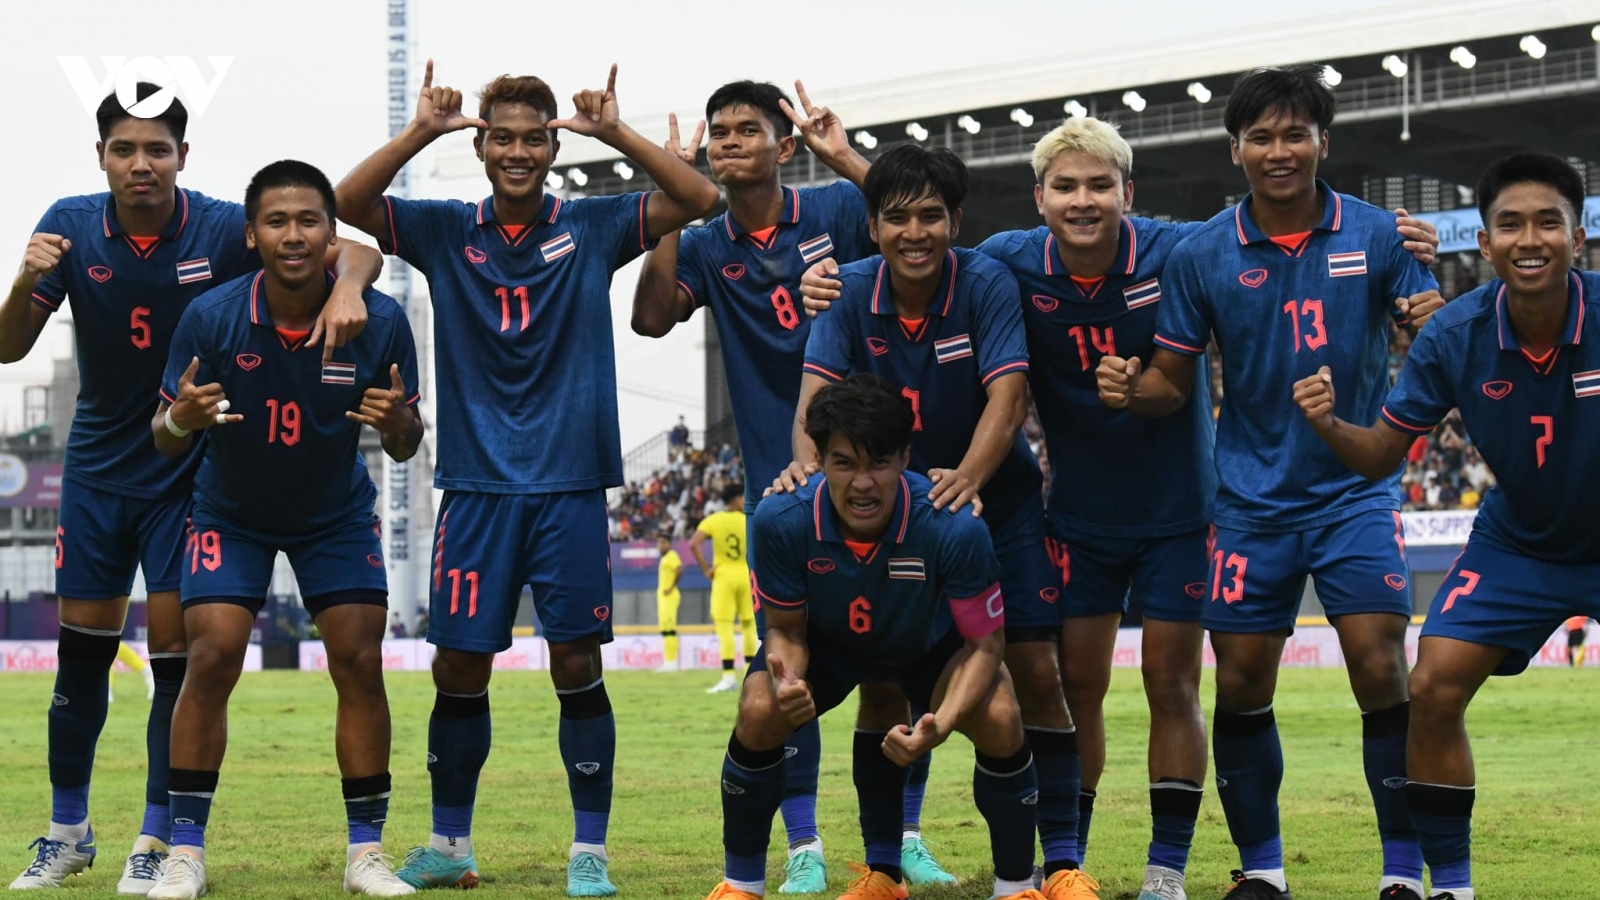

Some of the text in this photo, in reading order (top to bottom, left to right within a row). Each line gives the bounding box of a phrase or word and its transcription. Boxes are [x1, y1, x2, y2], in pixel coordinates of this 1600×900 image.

[130, 306, 151, 350] 5
[495, 286, 530, 331] 11
[770, 285, 799, 331] 8
[1283, 299, 1328, 352] 13
[1068, 325, 1116, 371] 14
[266, 399, 301, 446] 19
[1530, 415, 1553, 468] 7
[54, 525, 65, 569] 5
[190, 530, 222, 576] 19
[725, 534, 741, 561] 3
[447, 568, 479, 618] 11
[1211, 549, 1248, 604] 13
[1440, 569, 1481, 613] 7
[848, 596, 872, 634] 6
[1281, 641, 1319, 665] ulen
